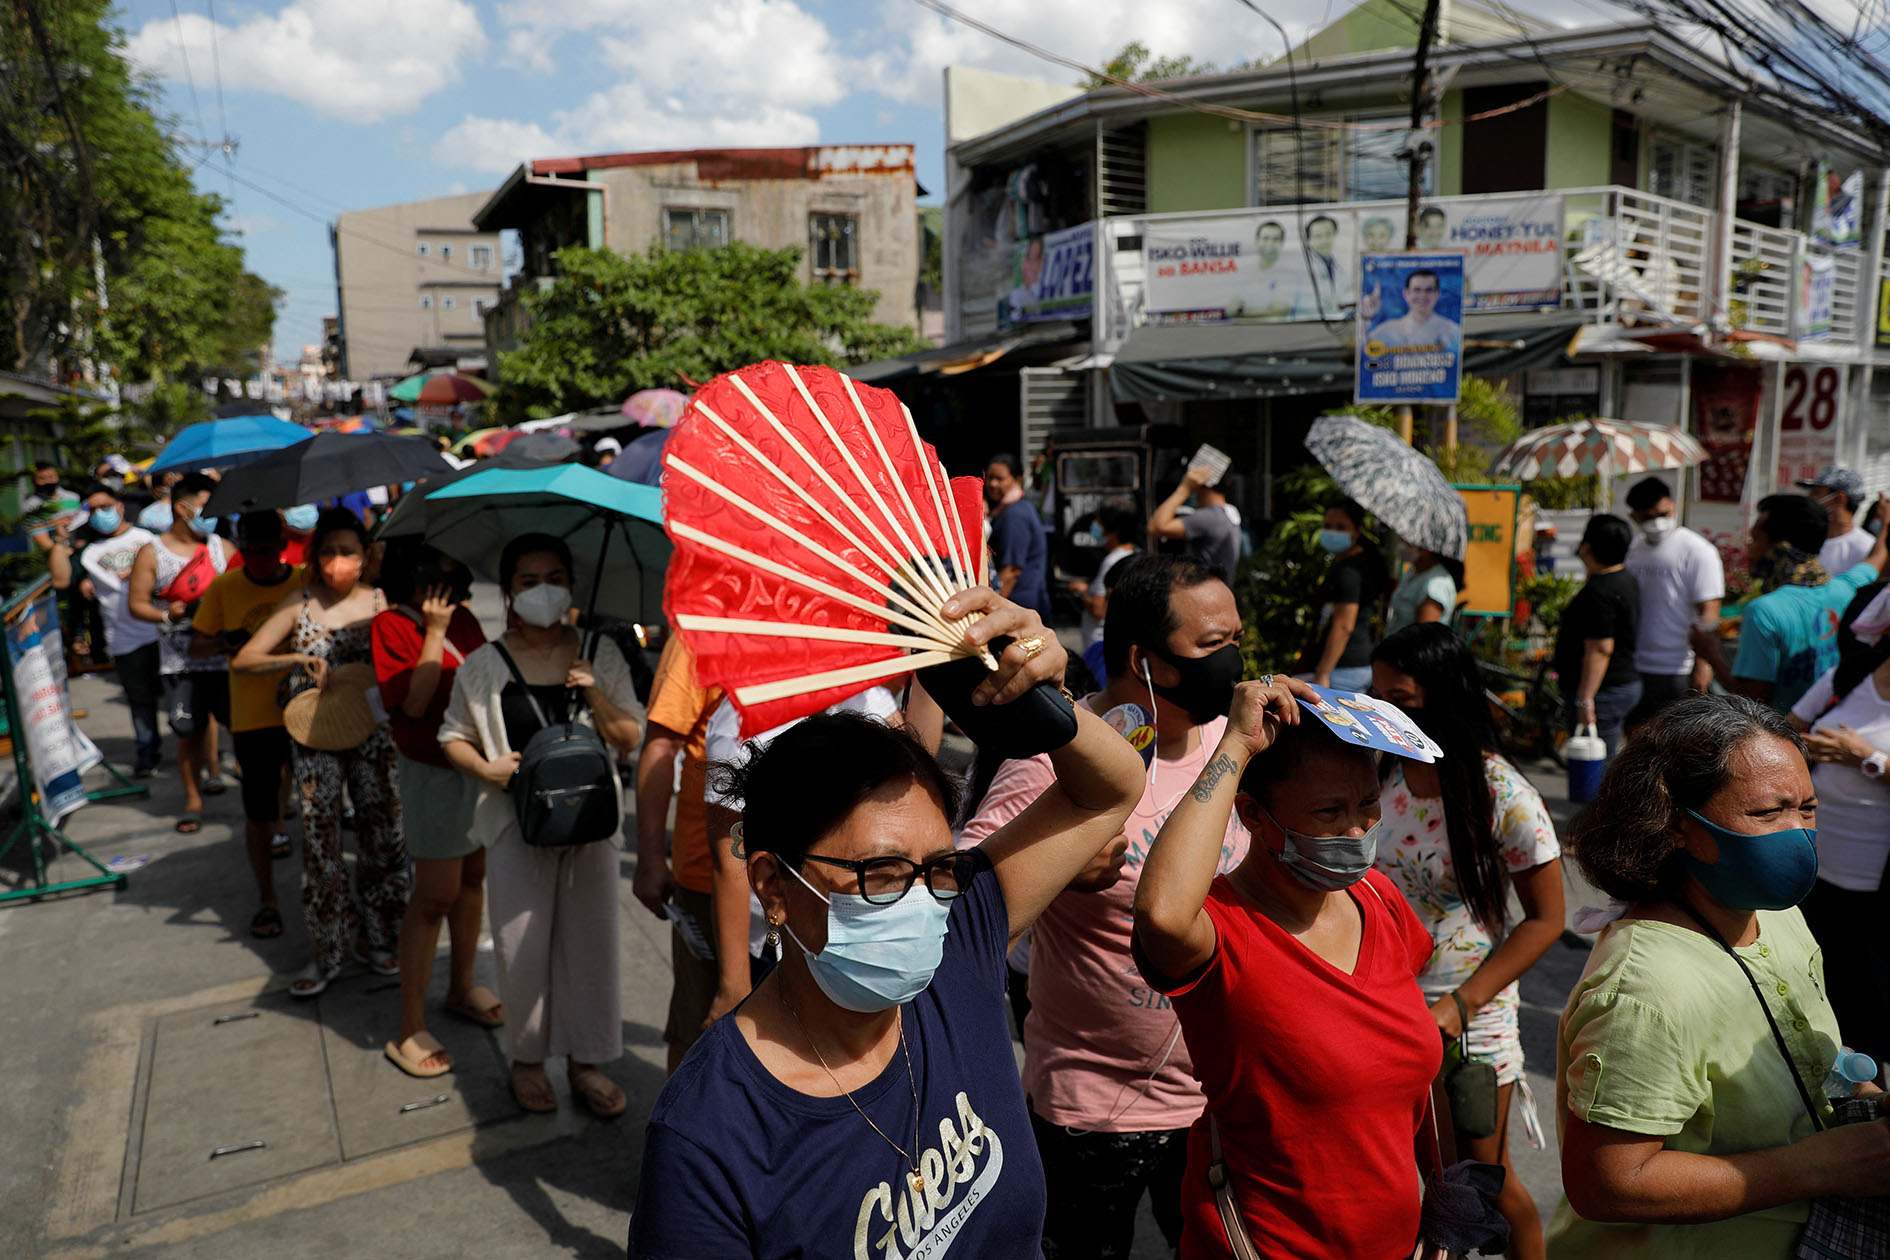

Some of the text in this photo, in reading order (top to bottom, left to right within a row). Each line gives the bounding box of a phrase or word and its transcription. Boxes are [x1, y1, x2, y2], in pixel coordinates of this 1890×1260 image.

[1781, 366, 1838, 430] 28
[854, 1091, 985, 1260] Guess
[934, 1188, 980, 1246] ANGELES
